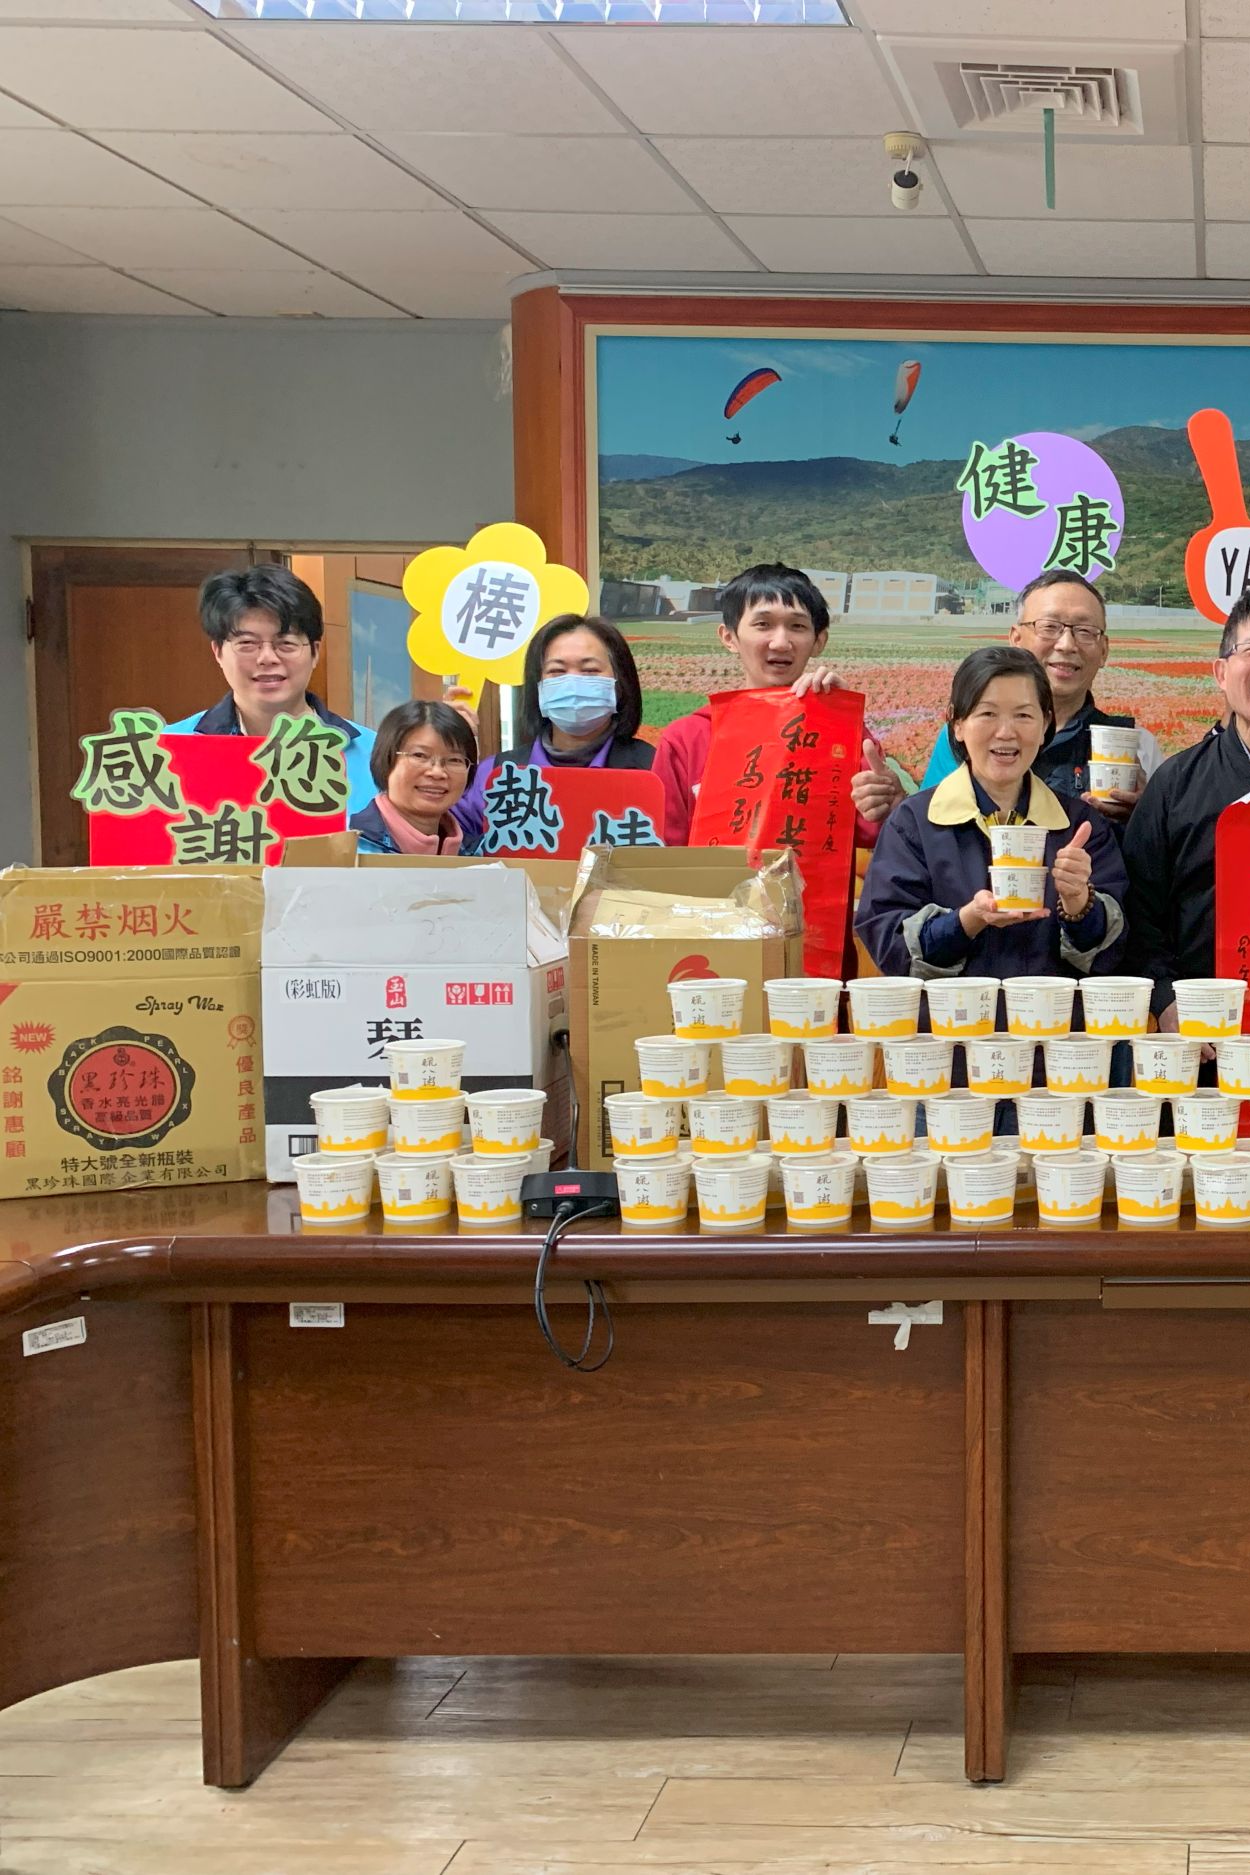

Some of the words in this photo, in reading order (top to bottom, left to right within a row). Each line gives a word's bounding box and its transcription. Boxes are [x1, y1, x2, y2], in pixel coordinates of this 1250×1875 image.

[960, 442, 1119, 575] 健康
[455, 567, 531, 649] 棒
[28, 901, 199, 941] 嚴禁烟火
[591, 944, 599, 966] MADE
[592, 968, 599, 976] IN
[285, 978, 342, 999] (彩虹版)
[592, 978, 600, 1006] TAIWAN
[136, 996, 183, 1015] Spray
[187, 995, 224, 1012] Wax
[19, 1032, 47, 1043] NEW
[58, 1038, 97, 1076] BLACK
[144, 1036, 188, 1074] PEARL
[80, 1066, 166, 1093] 黑珍珠
[2, 1066, 26, 1158] 銘謝惠顧
[235, 1055, 257, 1144] 優良產品
[60, 1107, 105, 1145] SPRAY
[61, 1149, 194, 1173] 特大號全新瓶裝
